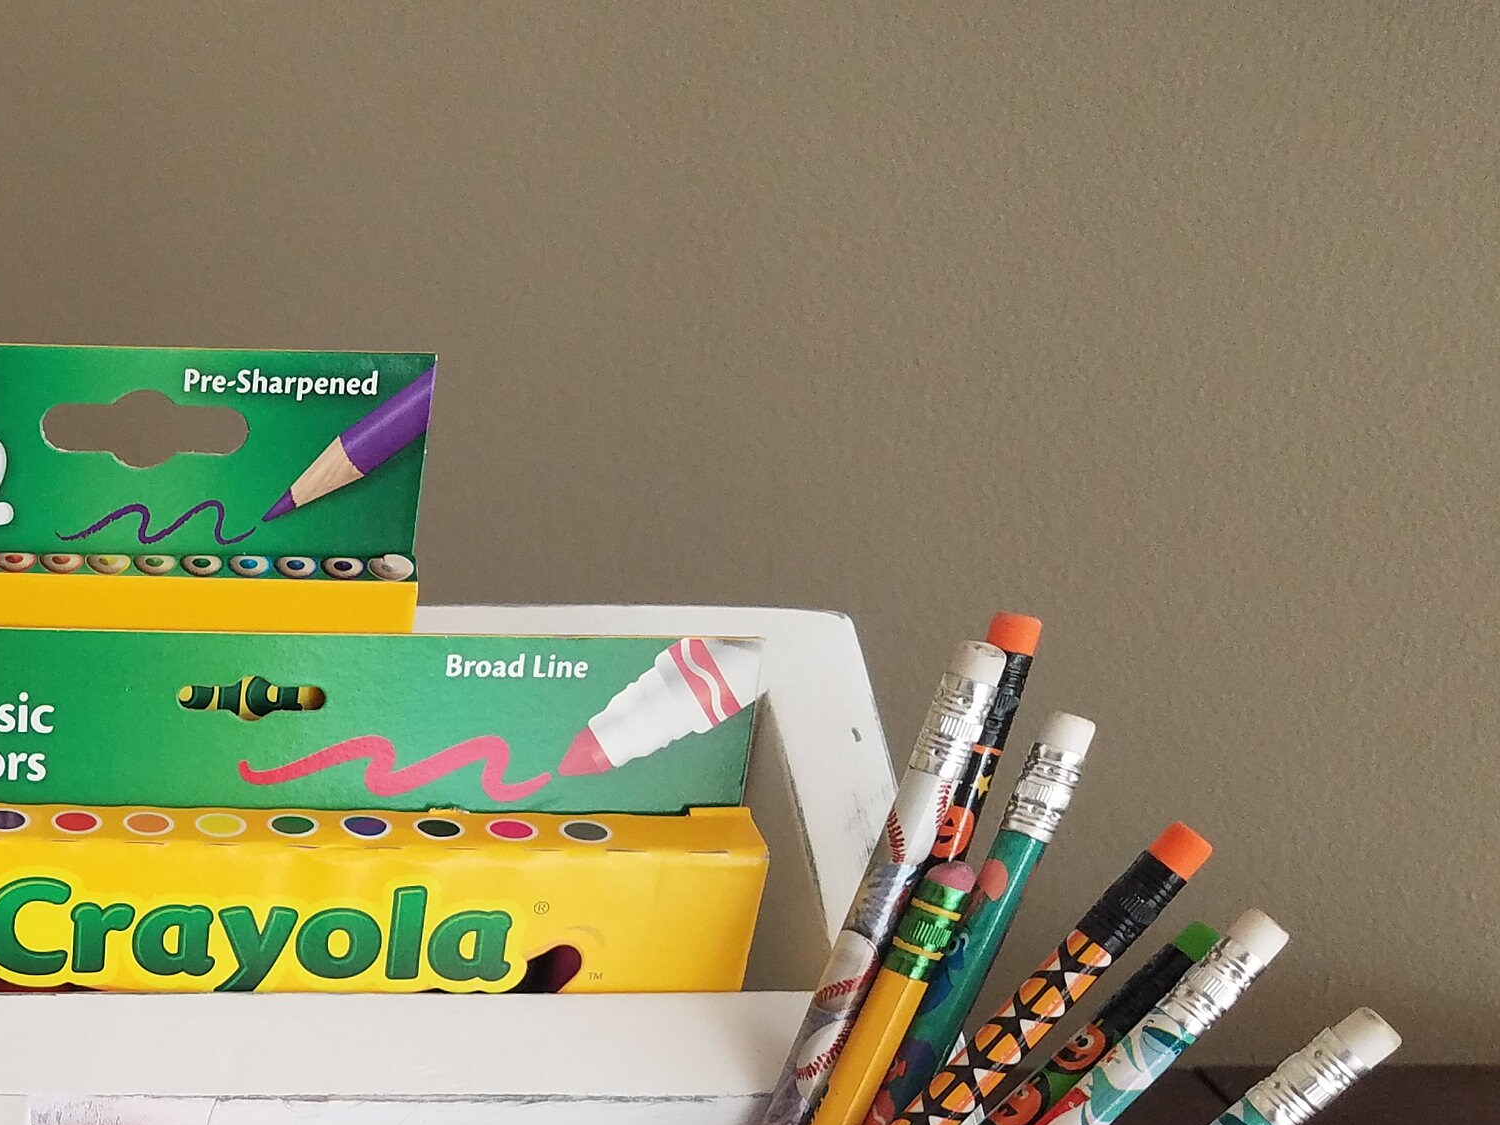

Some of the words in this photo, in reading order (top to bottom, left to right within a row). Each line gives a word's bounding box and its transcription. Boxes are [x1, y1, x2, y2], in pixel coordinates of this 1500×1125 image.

[184, 368, 379, 401] Pre-Sharpened
[445, 654, 524, 678] Broad
[533, 654, 589, 679] Line
